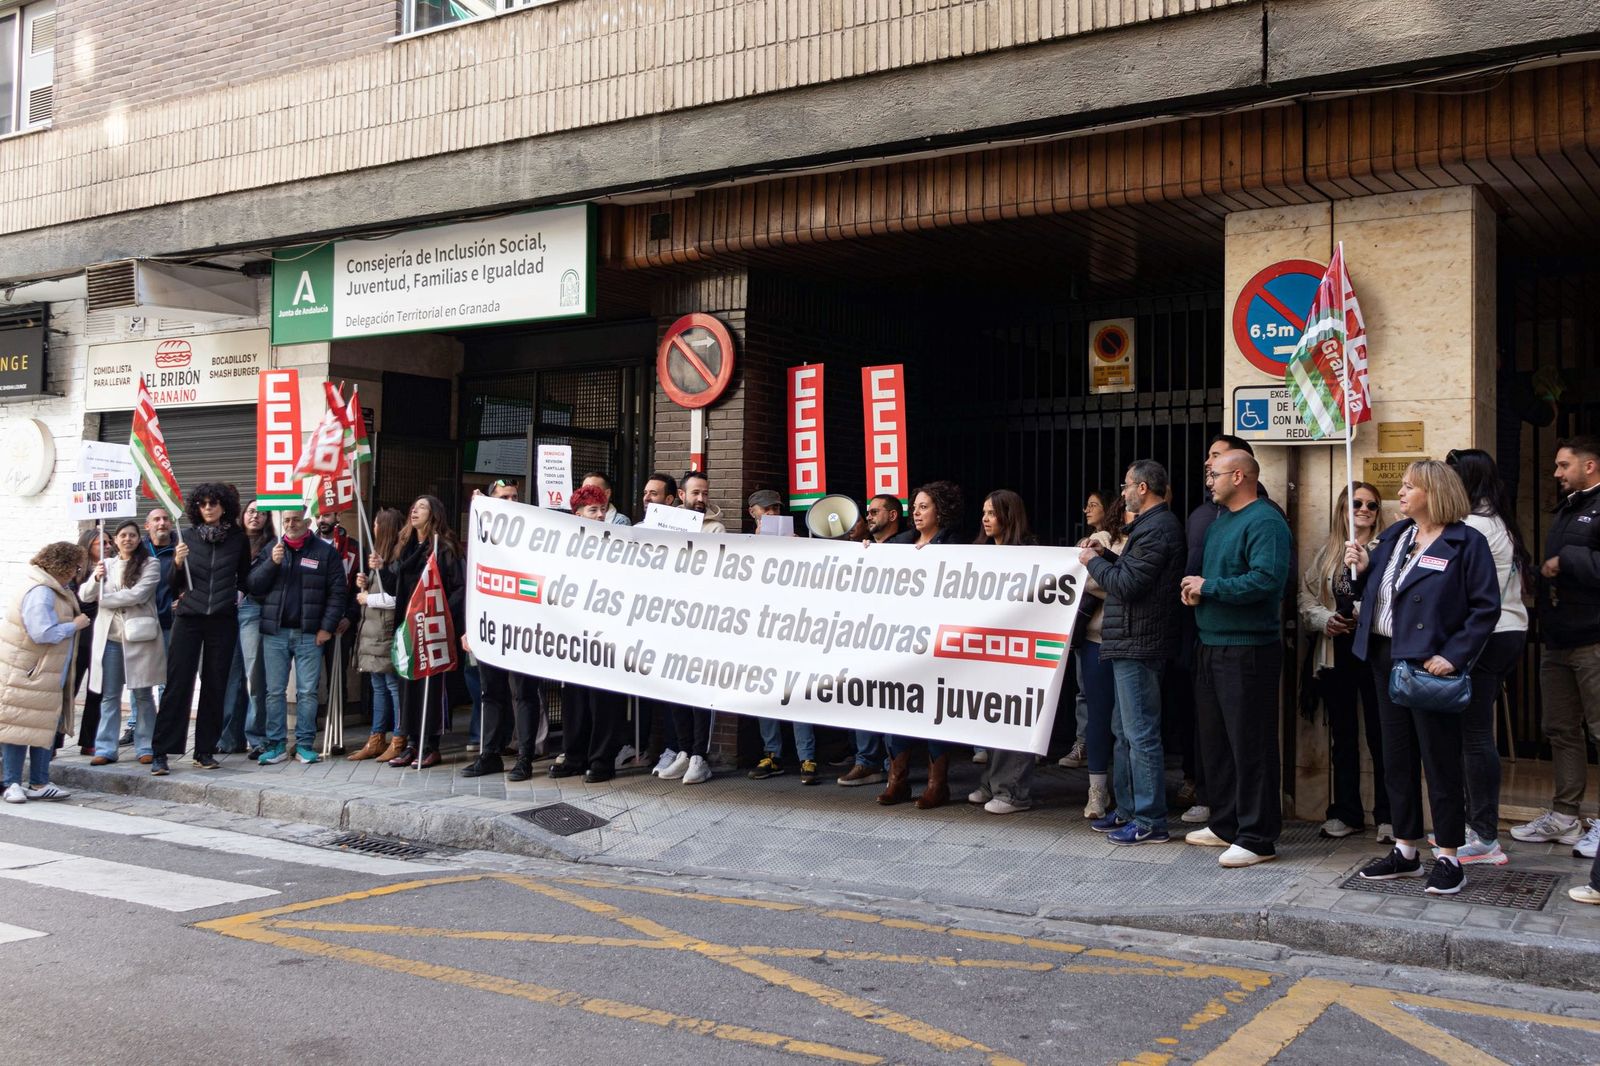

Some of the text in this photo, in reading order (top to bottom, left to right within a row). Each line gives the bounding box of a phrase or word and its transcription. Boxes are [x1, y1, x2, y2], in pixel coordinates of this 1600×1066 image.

[346, 232, 547, 274] Consejería de Inclusión Social,
[346, 256, 544, 296] Juventud, Familias e Igualdad
[278, 304, 329, 318] Junta de Andalucía
[345, 300, 501, 329] Delegación Territorial en Granada
[1250, 323, 1295, 340] 6,5m
[211, 353, 258, 366] BOCADILLOS Y
[93, 364, 132, 376] COMIDA LISTA
[146, 367, 201, 388] EL BRIBÓN
[209, 366, 260, 379] SMASH BURGER
[93, 377, 131, 387] PARA LLEVAR
[1270, 390, 1291, 398] EXCE
[1276, 402, 1289, 411] DE
[1272, 415, 1292, 425] CON
[266, 373, 294, 491] CCOO
[795, 368, 818, 490] CCOO
[871, 369, 899, 496] CCOO
[72, 479, 133, 492] QUE EL TRABAJO
[74, 490, 132, 504] NO NOS CUESTE
[547, 491, 563, 502] YA
[88, 502, 118, 514] LA VIDA
[528, 526, 561, 554] en
[566, 526, 669, 570] defensa
[674, 540, 708, 576] de
[713, 544, 755, 582] las
[761, 555, 927, 598] condiciones
[933, 560, 1077, 606] laborales
[547, 573, 579, 608] de
[583, 579, 625, 616] las
[626, 592, 751, 636] personas
[757, 603, 931, 656] trabajadoras
[940, 631, 1030, 659] CCOO
[414, 612, 429, 671] Granada
[479, 611, 497, 646] de
[502, 622, 617, 670] protección
[623, 639, 657, 676] de
[660, 652, 778, 696] menores
[780, 670, 801, 706] y
[804, 668, 925, 714] reforma
